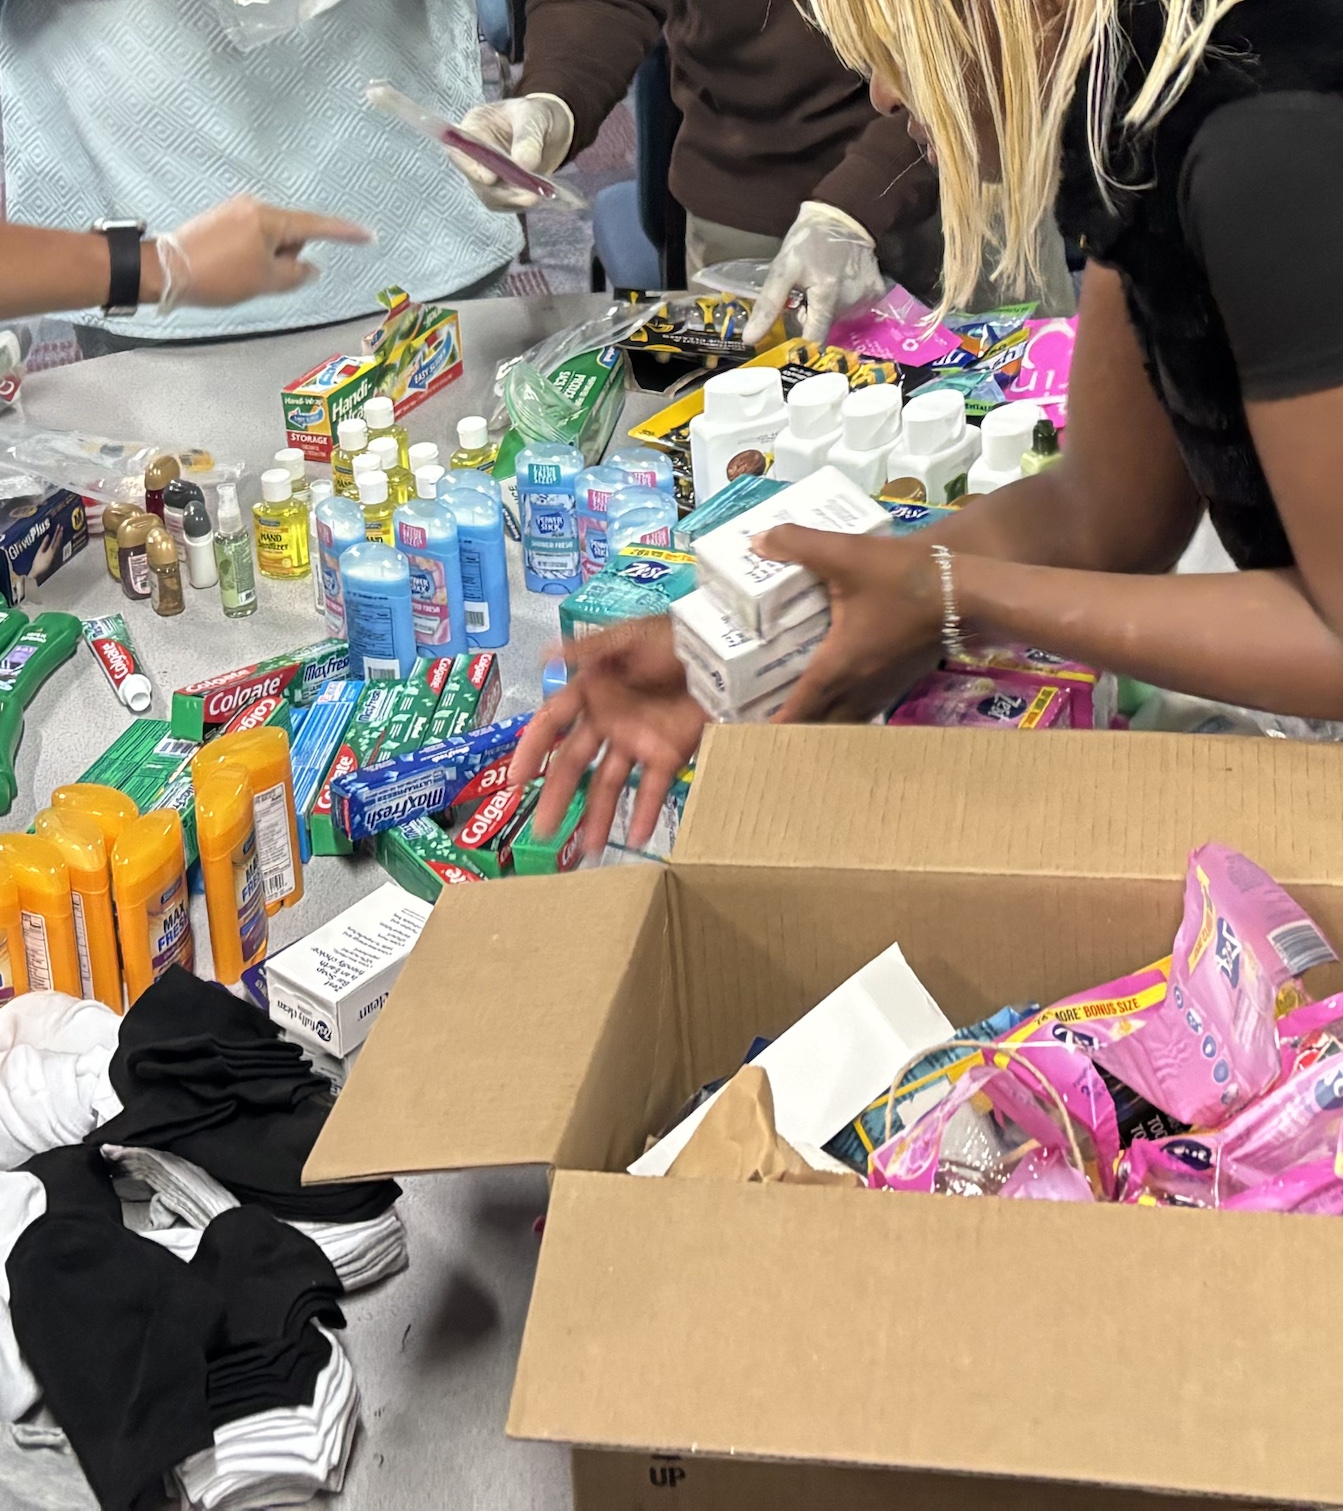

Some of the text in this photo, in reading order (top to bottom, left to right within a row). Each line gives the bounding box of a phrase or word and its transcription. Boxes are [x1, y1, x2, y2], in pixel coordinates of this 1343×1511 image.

[332, 378, 373, 423] Handi-
[291, 433, 328, 445] STORAGE
[102, 642, 129, 679] Colgate
[430, 657, 452, 689] Colgate
[471, 653, 493, 685] Colgate
[186, 668, 251, 693] Colgate
[208, 675, 283, 716] Colgate
[237, 698, 276, 734] Colg
[365, 786, 446, 830] MaxFresh
[461, 784, 519, 844] Colga
[163, 898, 185, 934] MAX
[316, 967, 350, 986] Bar Soap
[319, 959, 341, 973] Earth
[338, 962, 366, 976] friendly
[324, 980, 343, 992] Zest
[277, 999, 298, 1020] clean
[1083, 1003, 1117, 1018] BONUS
[1116, 998, 1140, 1013] SIZE
[295, 1010, 316, 1032] fully
[649, 1467, 687, 1489] UP
